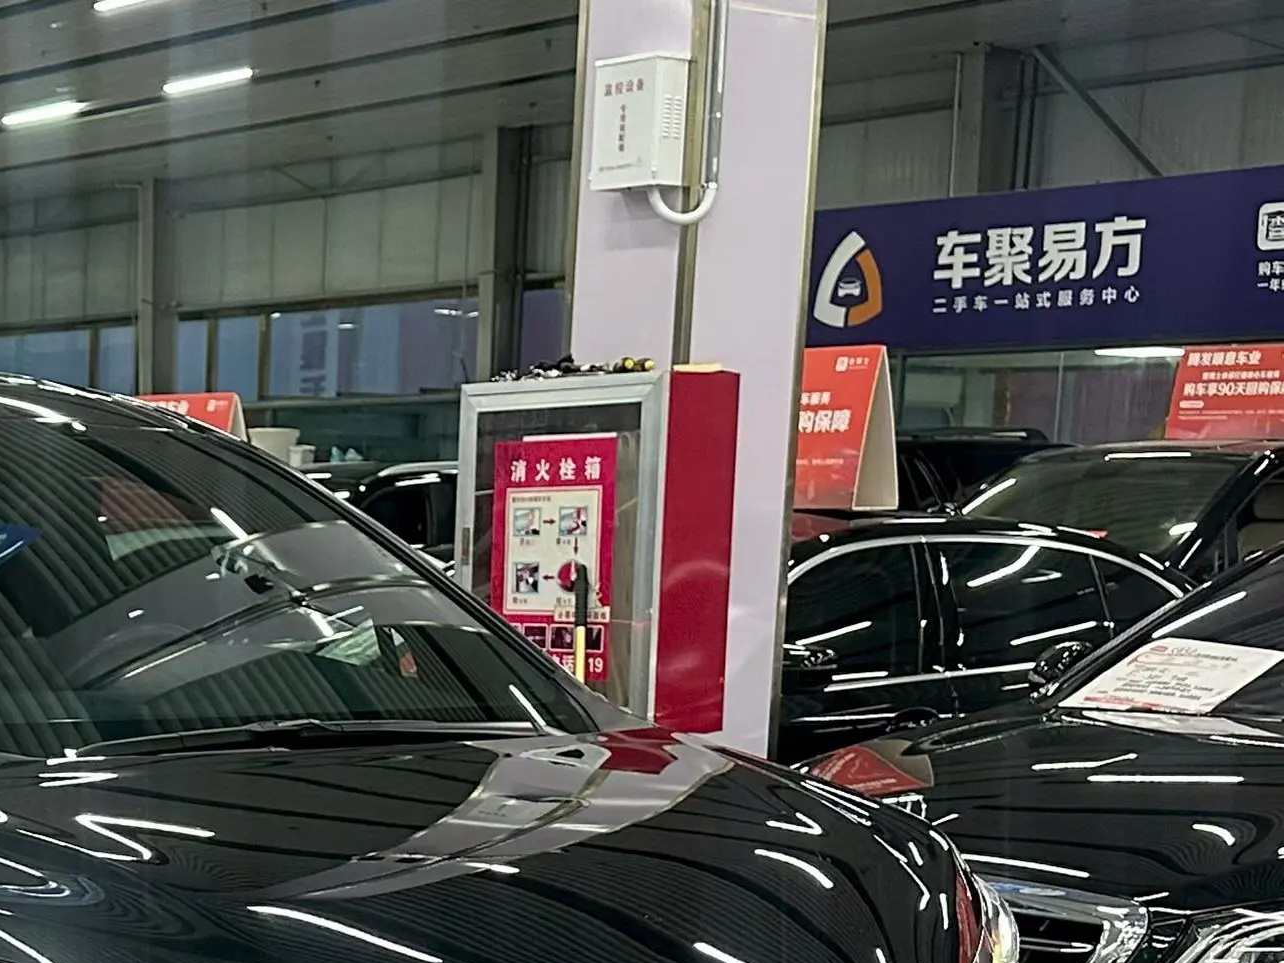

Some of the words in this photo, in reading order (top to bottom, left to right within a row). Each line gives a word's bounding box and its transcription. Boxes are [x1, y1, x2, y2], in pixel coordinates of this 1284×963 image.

[933, 216, 1147, 289] 车聚易方
[1257, 278, 1284, 292] 一年
[932, 286, 1140, 313] 二手车一站式服务中心
[1183, 381, 1284, 397] 购车享90天回购保
[798, 409, 851, 433] 购保障
[511, 456, 601, 482] 消火栓箱
